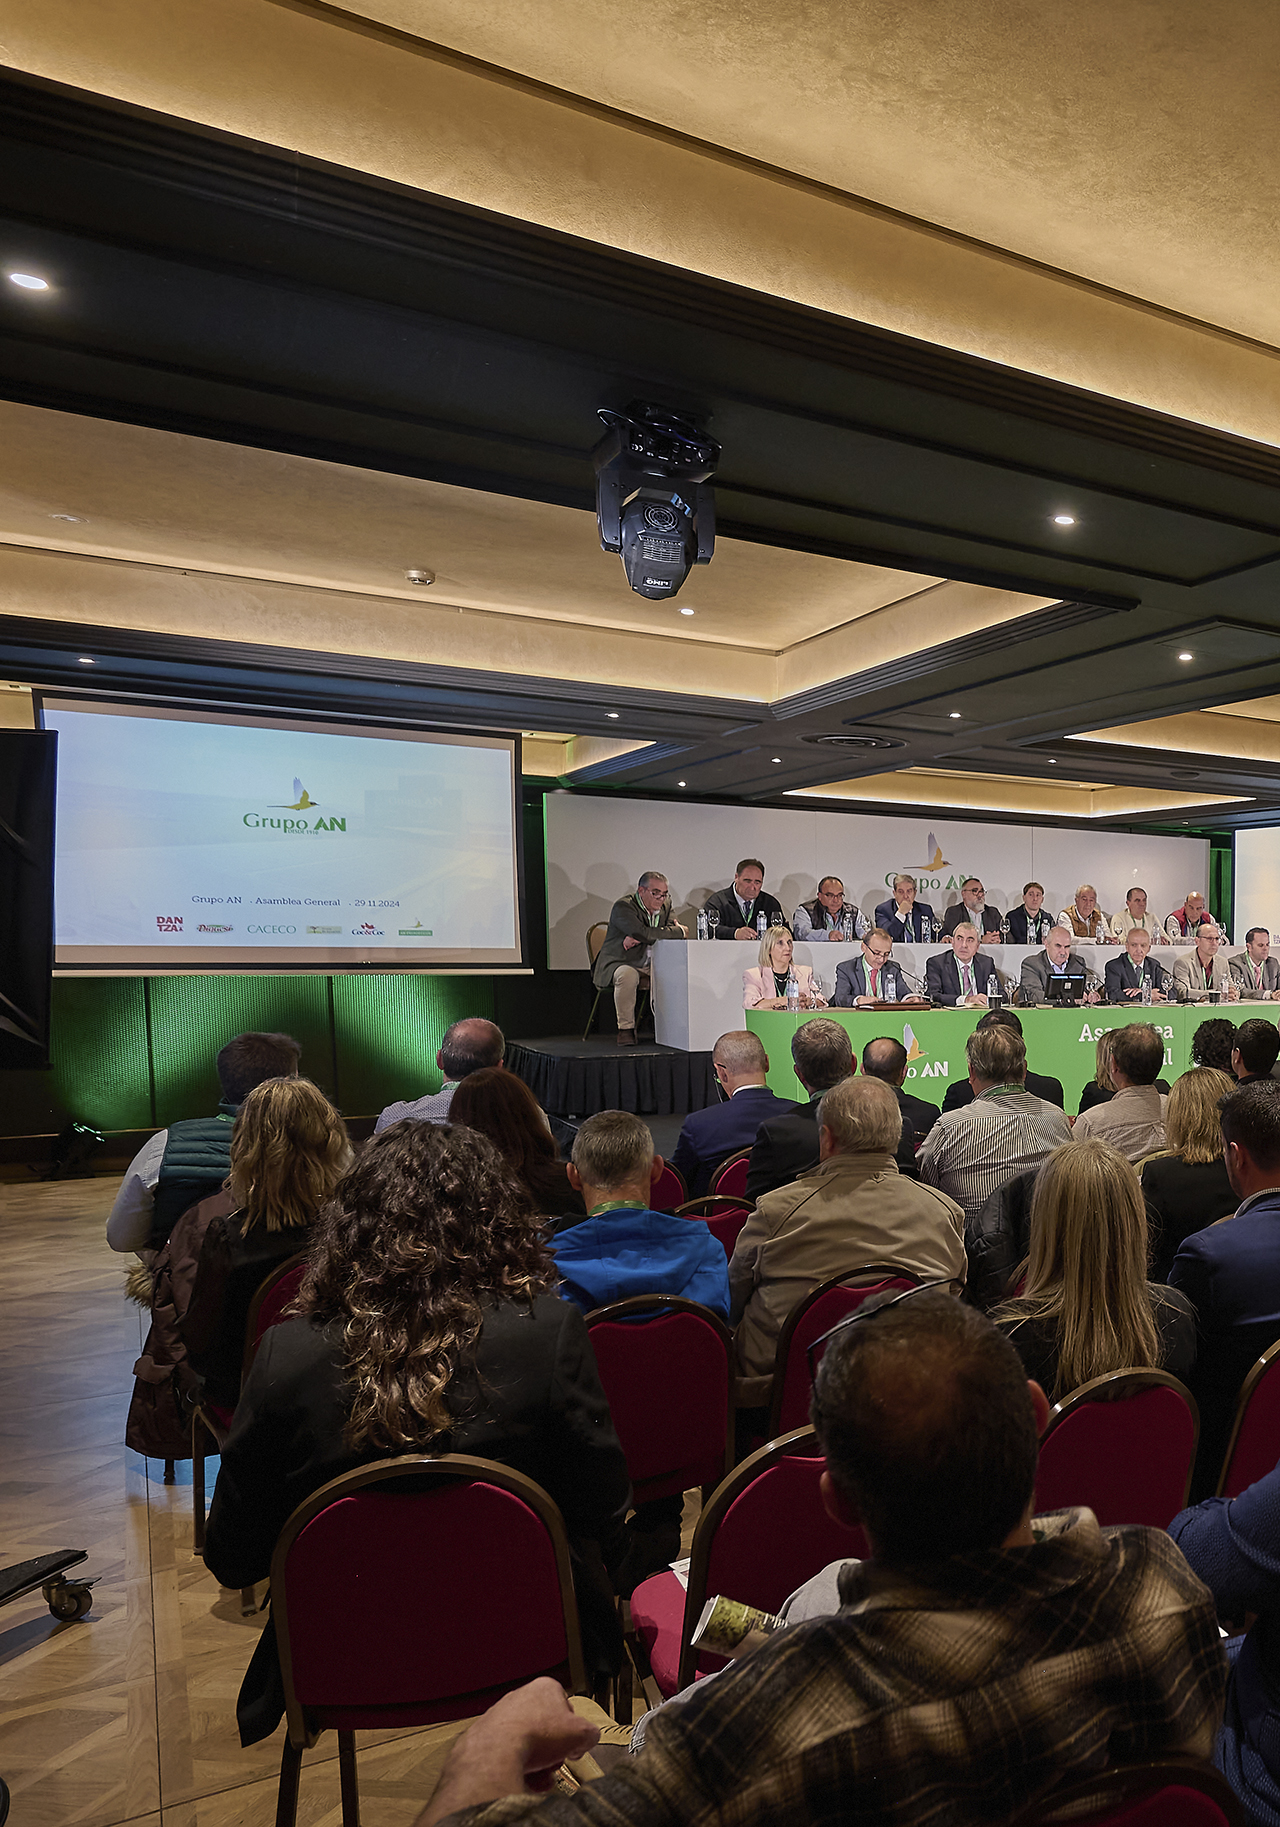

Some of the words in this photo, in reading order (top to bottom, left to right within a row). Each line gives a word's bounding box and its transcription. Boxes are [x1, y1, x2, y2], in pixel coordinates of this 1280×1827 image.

[243, 813, 309, 833] Grupo
[313, 817, 347, 832] AN
[885, 872, 941, 894] Gpo
[191, 895, 224, 905] Grupo
[226, 896, 242, 904] AN
[255, 897, 302, 906] Asamblea
[304, 898, 341, 906] General
[156, 916, 184, 924] DAN
[157, 924, 178, 932] TZA
[247, 924, 297, 934] CACECO
[920, 1061, 949, 1078] AN
